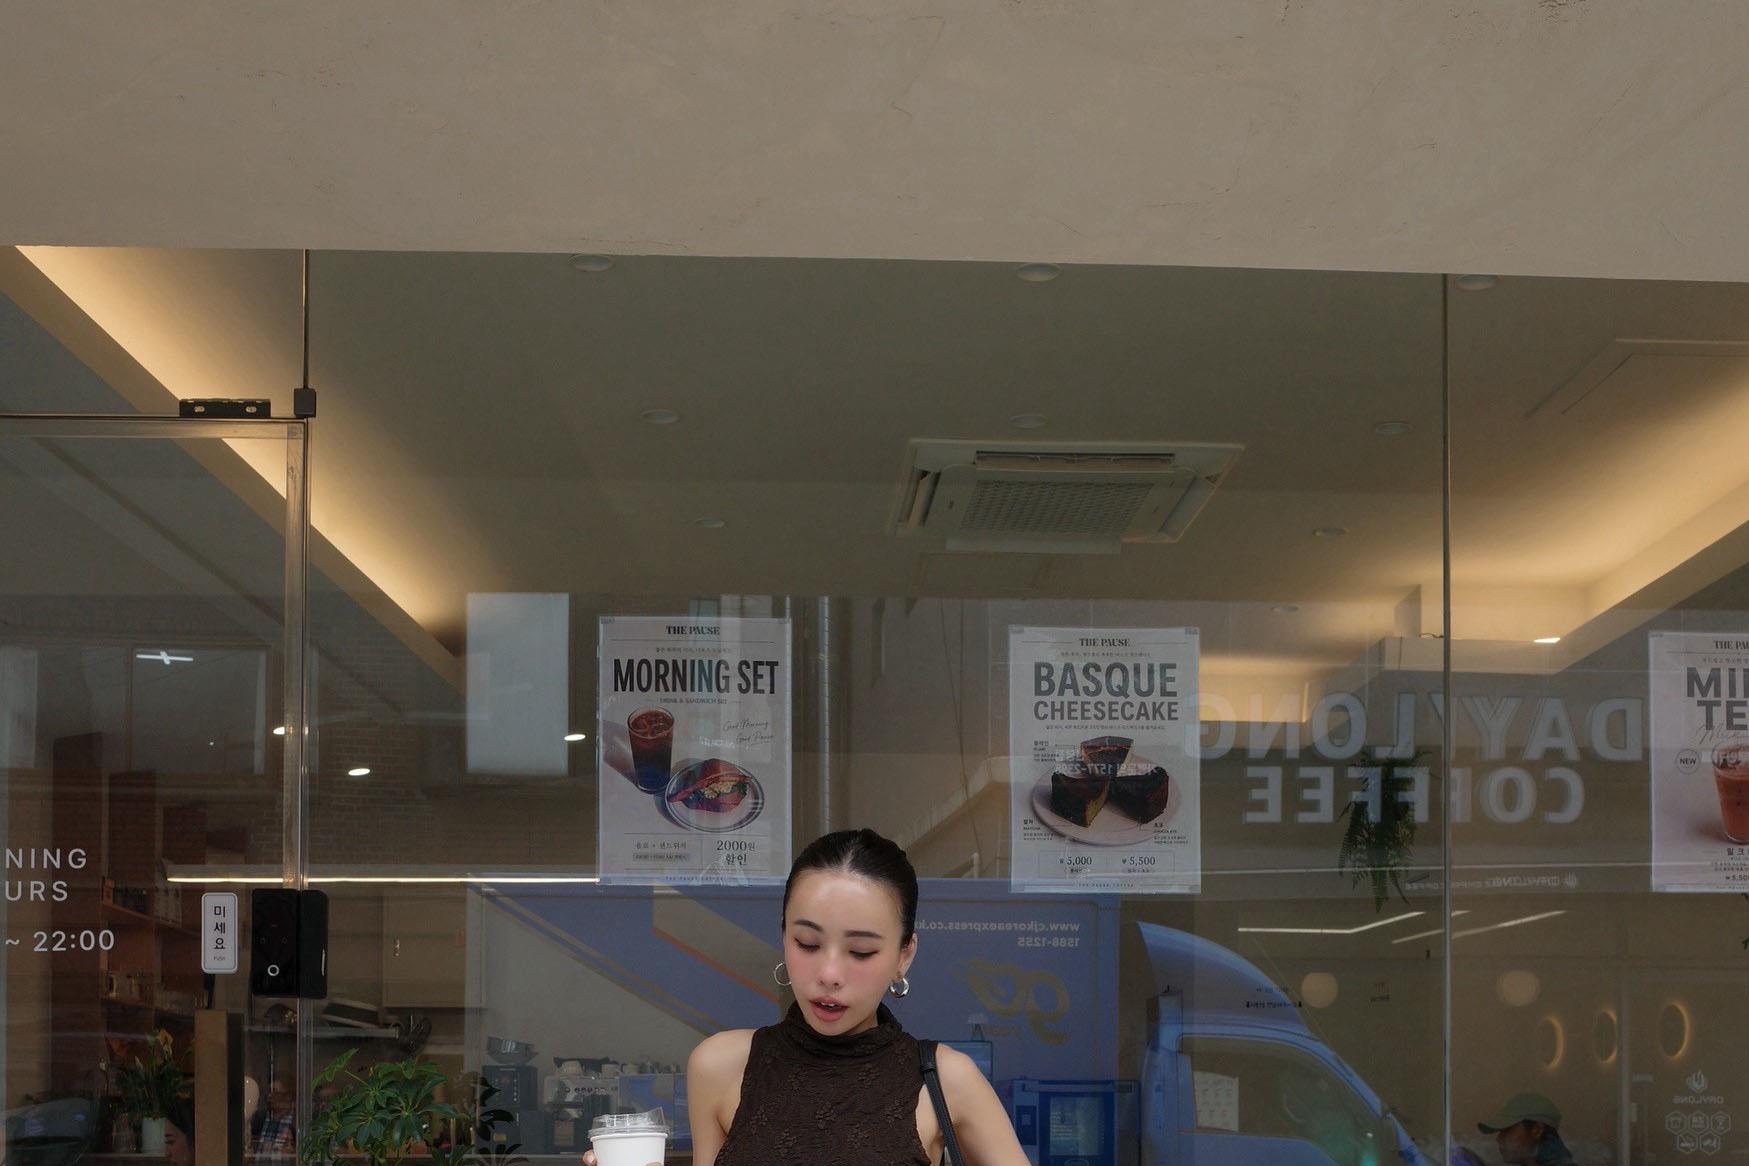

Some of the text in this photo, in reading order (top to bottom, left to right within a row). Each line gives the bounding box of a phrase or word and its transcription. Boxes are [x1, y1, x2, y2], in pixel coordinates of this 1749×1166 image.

[666, 625, 720, 636] THE PAUSE
[1080, 638, 1130, 647] THE PAUSE
[1714, 640, 1734, 649] THE
[614, 659, 779, 694] MORNING SET
[1034, 662, 1178, 699] BASQUE
[1034, 701, 1179, 721] CHEESECAKE
[1679, 758, 1696, 766] NEW
[5, 848, 87, 870] NING
[1067, 857, 1092, 866] 5,000
[1129, 857, 1156, 866] 5,500
[5, 880, 69, 902] URS
[213, 905, 226, 950] 미세요
[33, 930, 115, 952] 22:00
